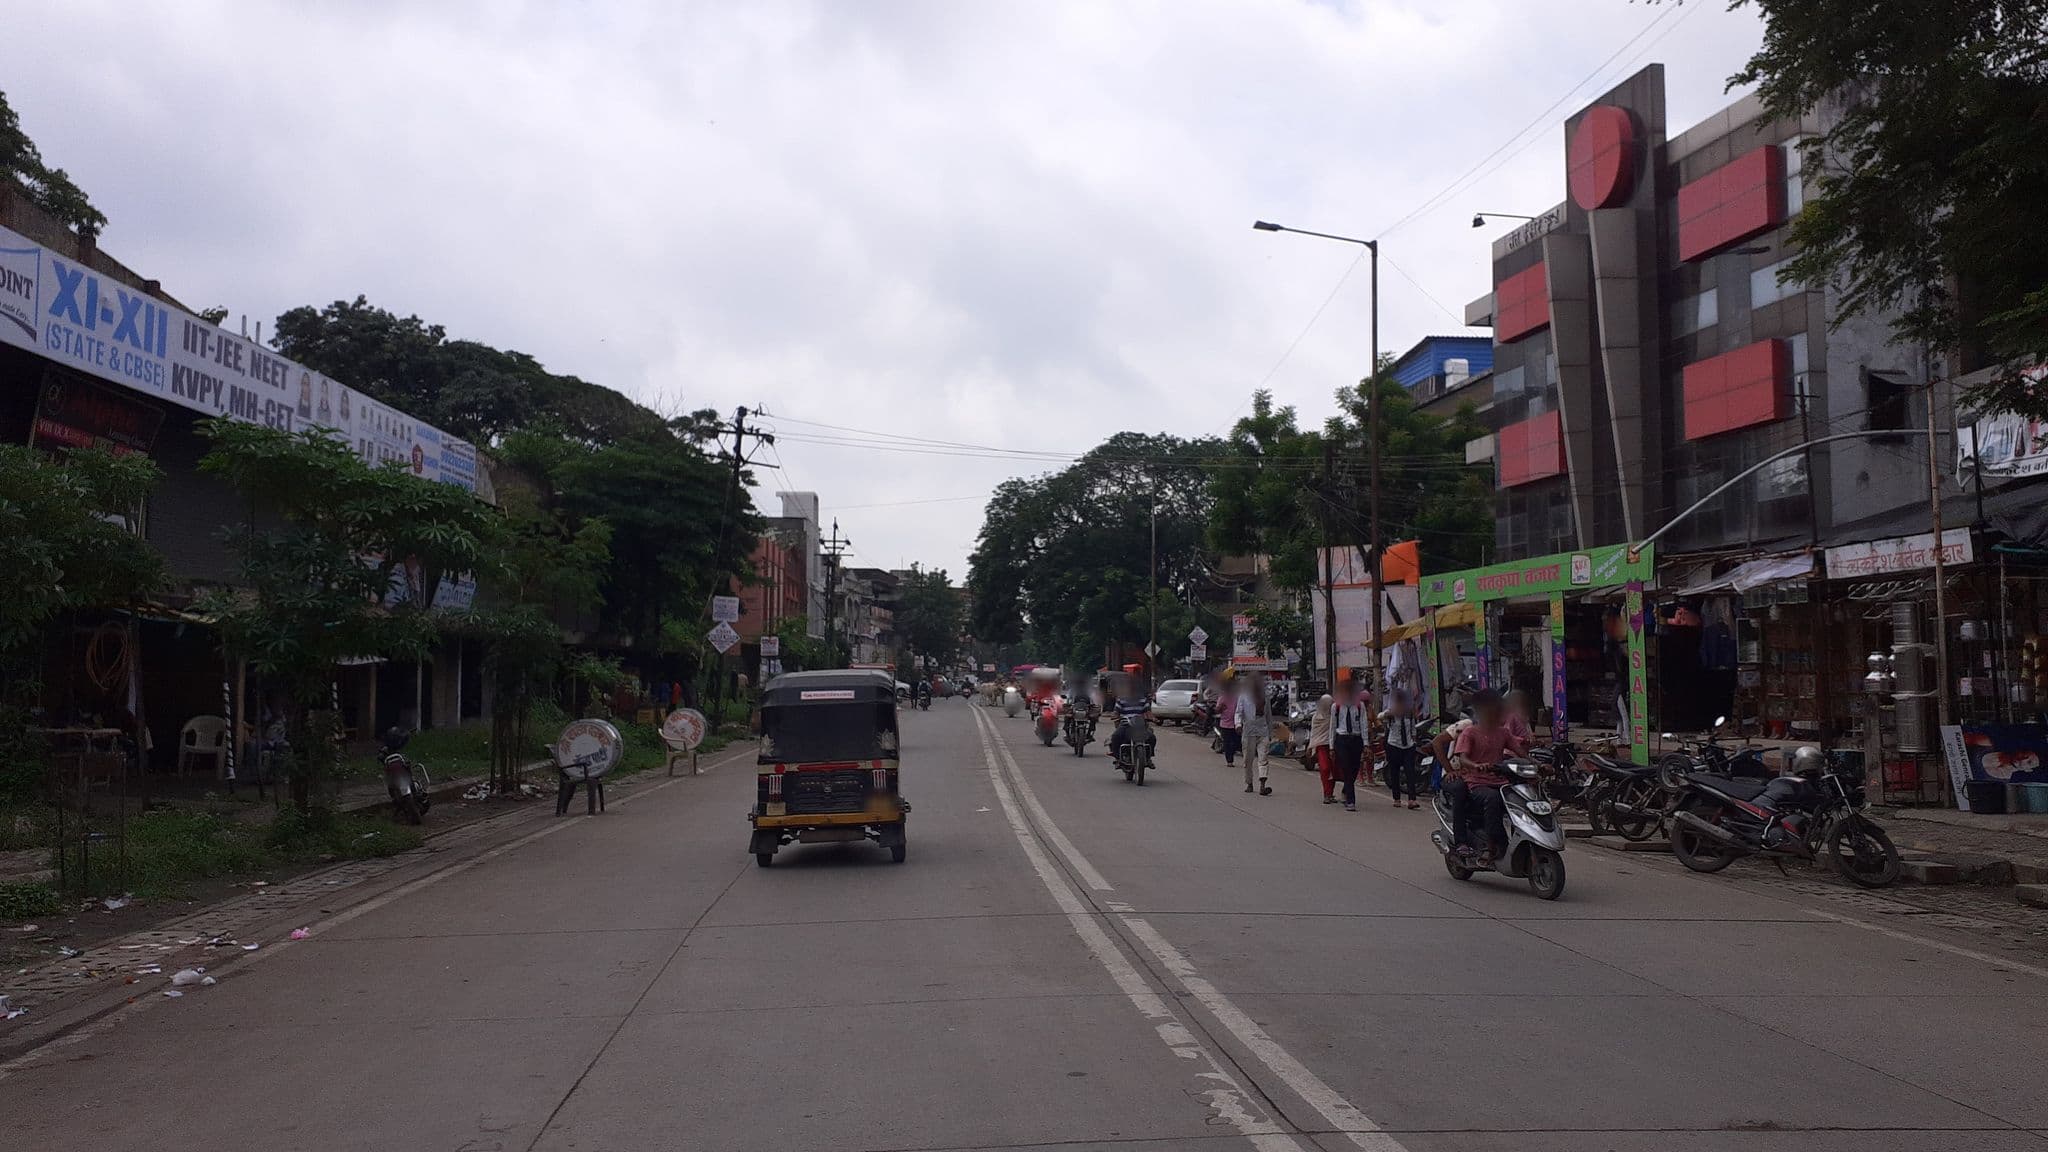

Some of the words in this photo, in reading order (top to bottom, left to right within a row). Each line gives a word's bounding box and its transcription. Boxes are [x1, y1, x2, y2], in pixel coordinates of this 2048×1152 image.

[48, 260, 168, 359] XI-XII
[46, 320, 105, 366] (STATE
[109, 346, 121, 371] &
[124, 351, 165, 391] CBSE)
[183, 319, 246, 376] IIT-JEE,
[250, 350, 289, 390] NEET
[171, 362, 225, 412] KVPY,
[229, 385, 294, 432] MH-CET
[1632, 651, 1644, 745] SALE
